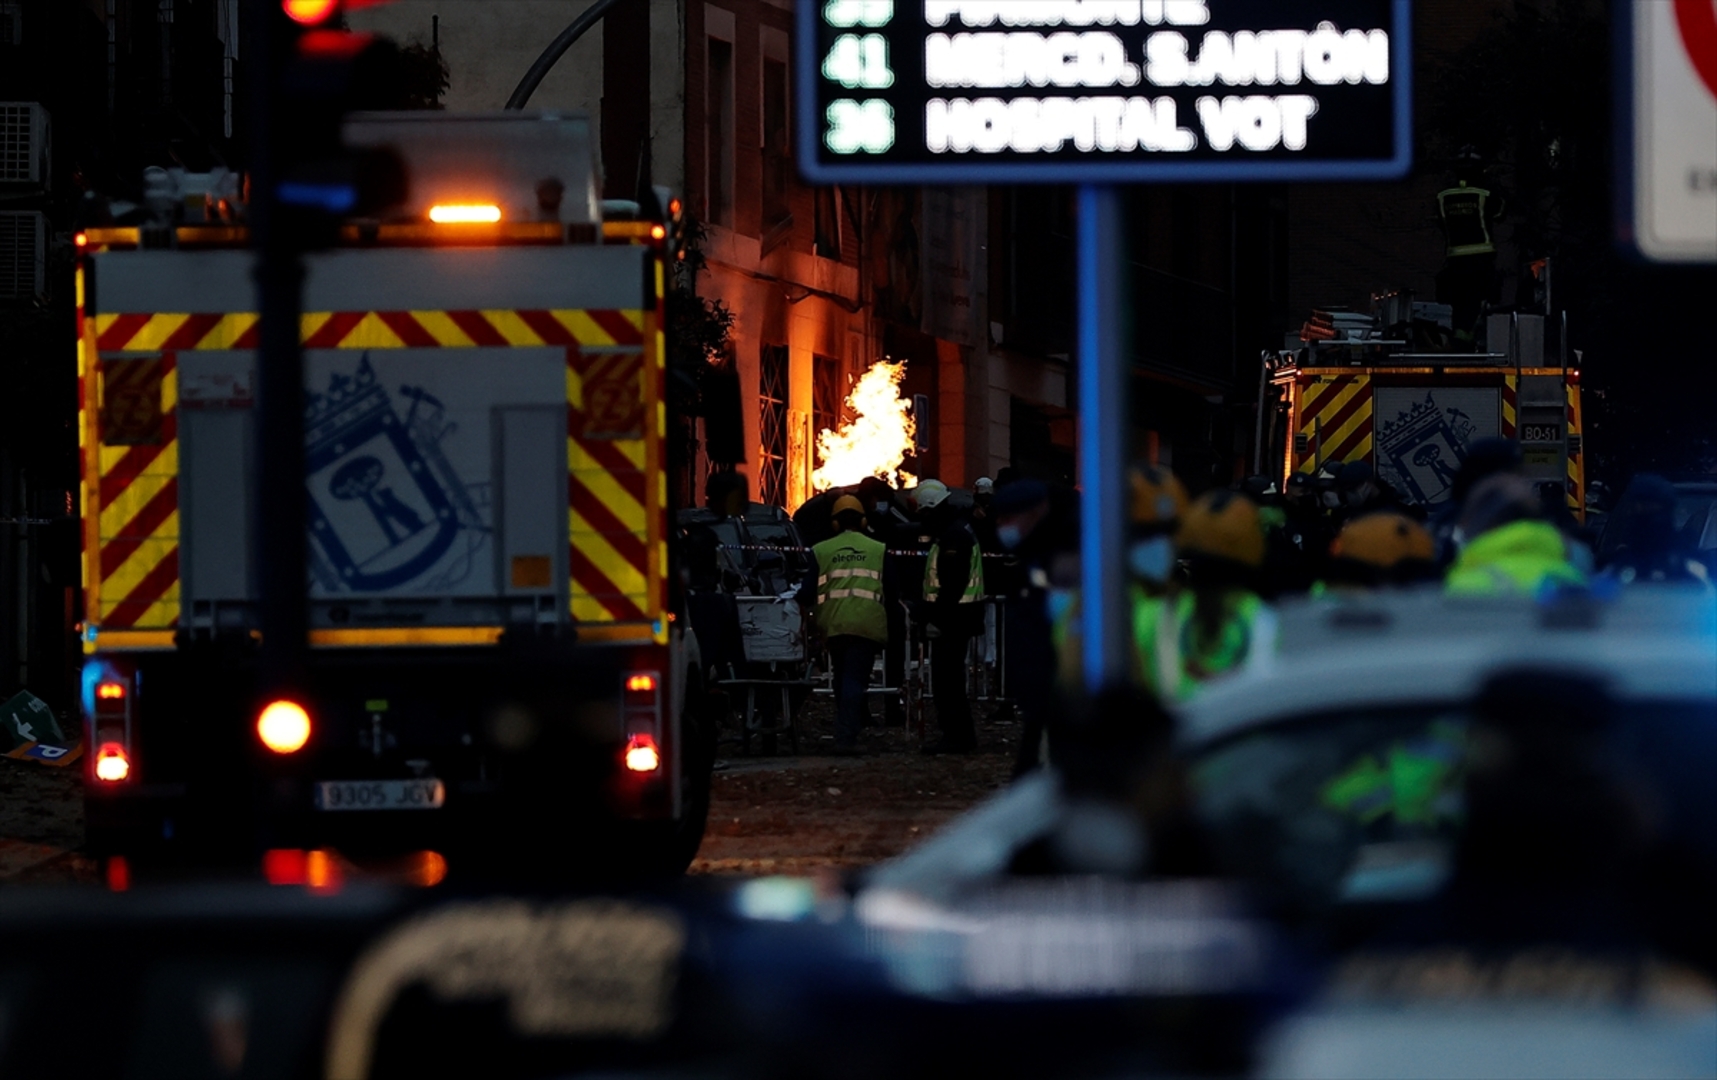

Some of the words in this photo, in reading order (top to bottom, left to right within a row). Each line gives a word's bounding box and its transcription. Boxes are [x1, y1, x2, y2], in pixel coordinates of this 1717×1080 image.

[822, 33, 894, 88] 41
[925, 96, 1195, 153] HOSPITAL
[1197, 95, 1318, 151] VOT
[832, 553, 867, 563] elecnor
[328, 784, 388, 806] 9305
